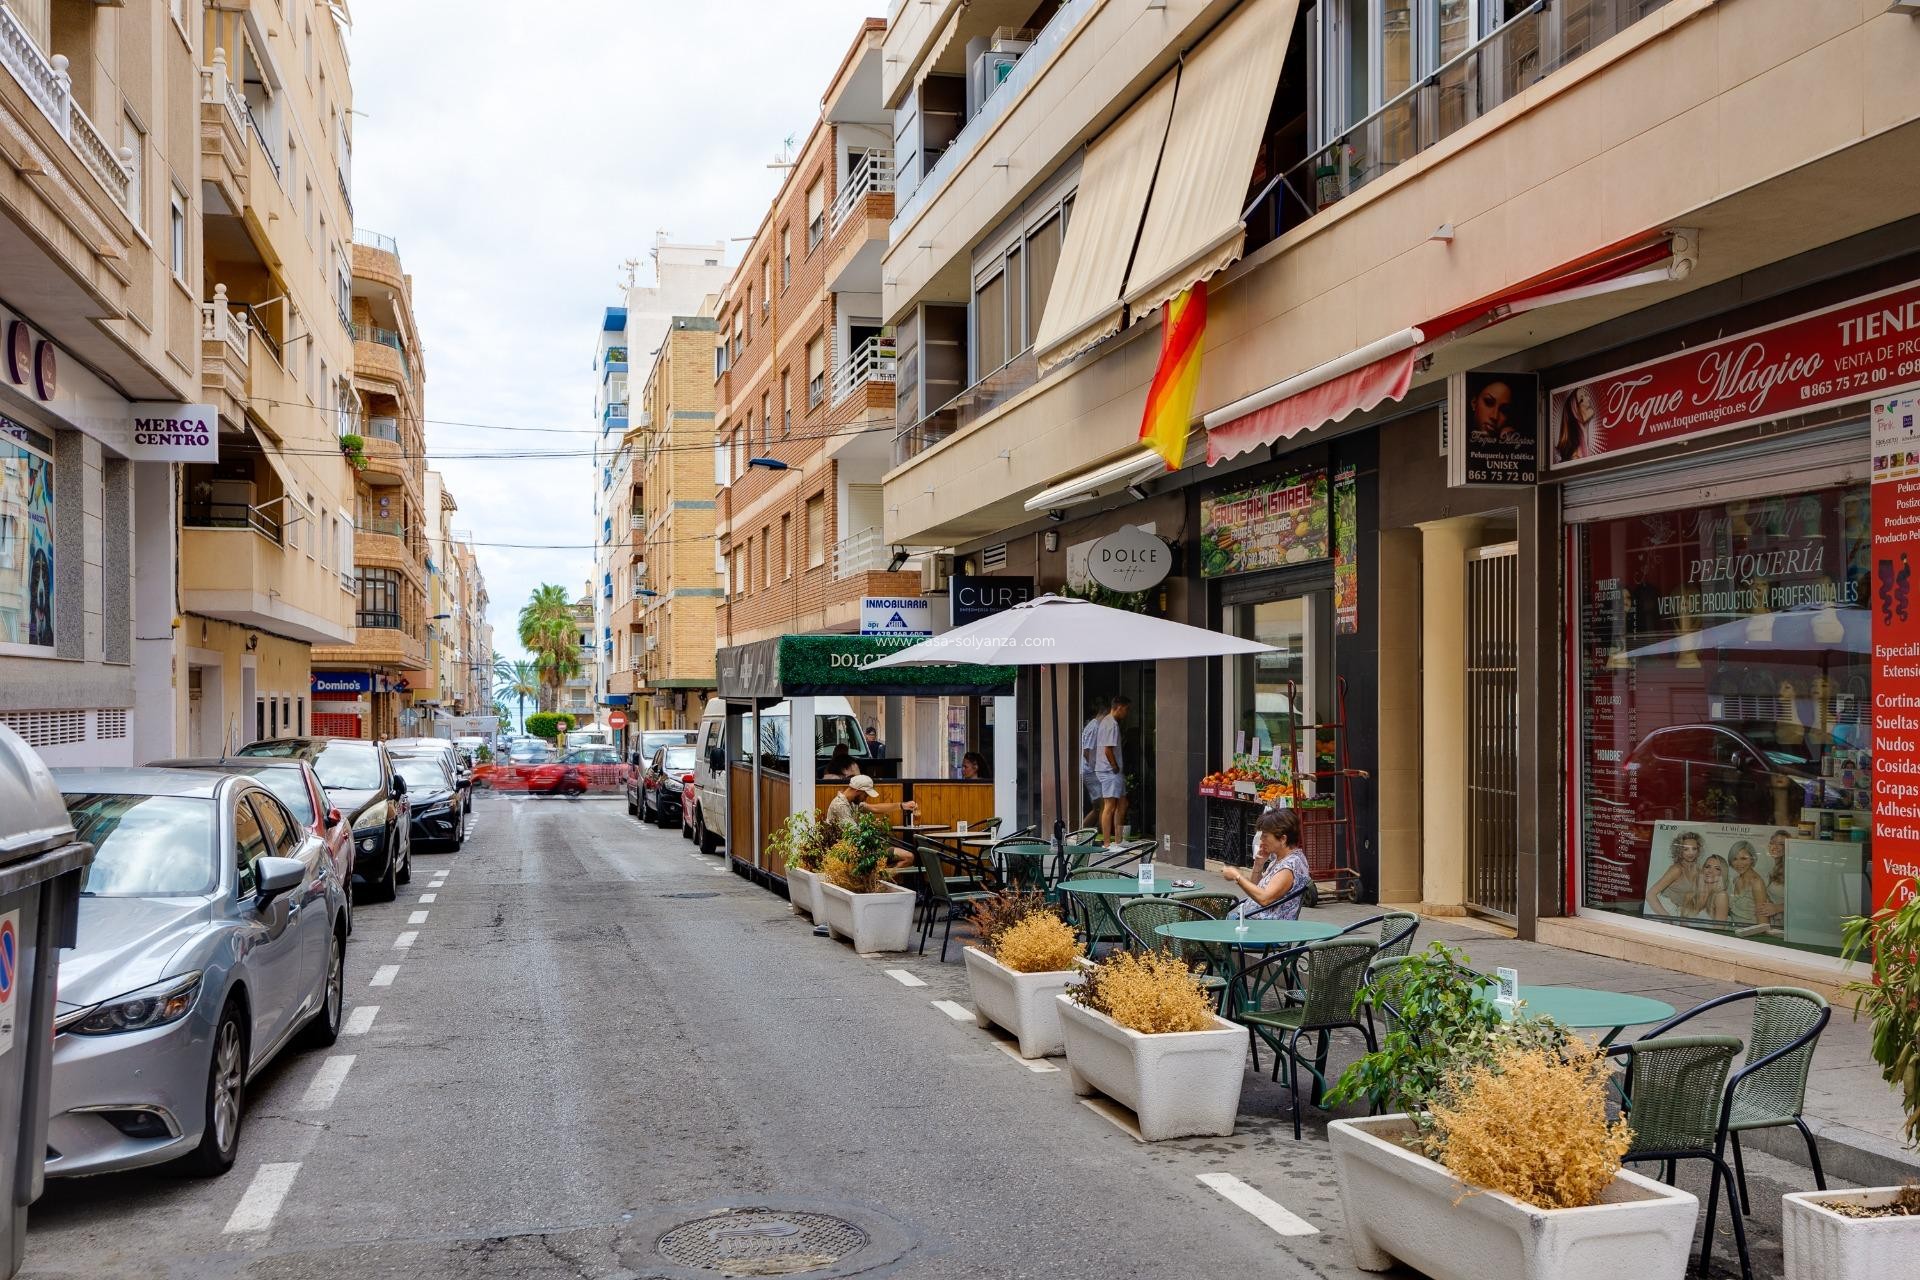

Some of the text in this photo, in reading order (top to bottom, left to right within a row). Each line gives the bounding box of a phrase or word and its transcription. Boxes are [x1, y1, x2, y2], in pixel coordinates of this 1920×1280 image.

[1834, 351, 1873, 372] VENTA
[1877, 345, 1894, 362] DE
[1811, 381, 1832, 397] 865
[1836, 376, 1850, 391] 75
[1854, 372, 1868, 387] 72
[1871, 367, 1887, 381] 00
[1898, 359, 1920, 377] 698
[1602, 343, 1824, 436] Toque Mágico
[1650, 401, 1746, 433] www.toquemagico.es
[134, 418, 209, 433] MERCA
[134, 433, 209, 446] CENTRO
[1487, 461, 1519, 470] UNISEX
[1468, 470, 1535, 482] 865 75 72 00
[1267, 483, 1312, 517] ISMAEL
[1875, 531, 1907, 544] Producto
[1103, 549, 1157, 562] DOLCE
[1688, 541, 1825, 585] PELUQUERÍA
[866, 599, 928, 609] INMOBILIARIA
[1657, 581, 1859, 616] VENTA DE PRODUCTOS A PROFESIONALES
[1876, 642, 1920, 661] Especiali
[317, 679, 361, 690] Domino's
[1876, 714, 1919, 730] Sueltas
[1876, 736, 1915, 752] Nudos
[1876, 779, 1919, 800] Grapas
